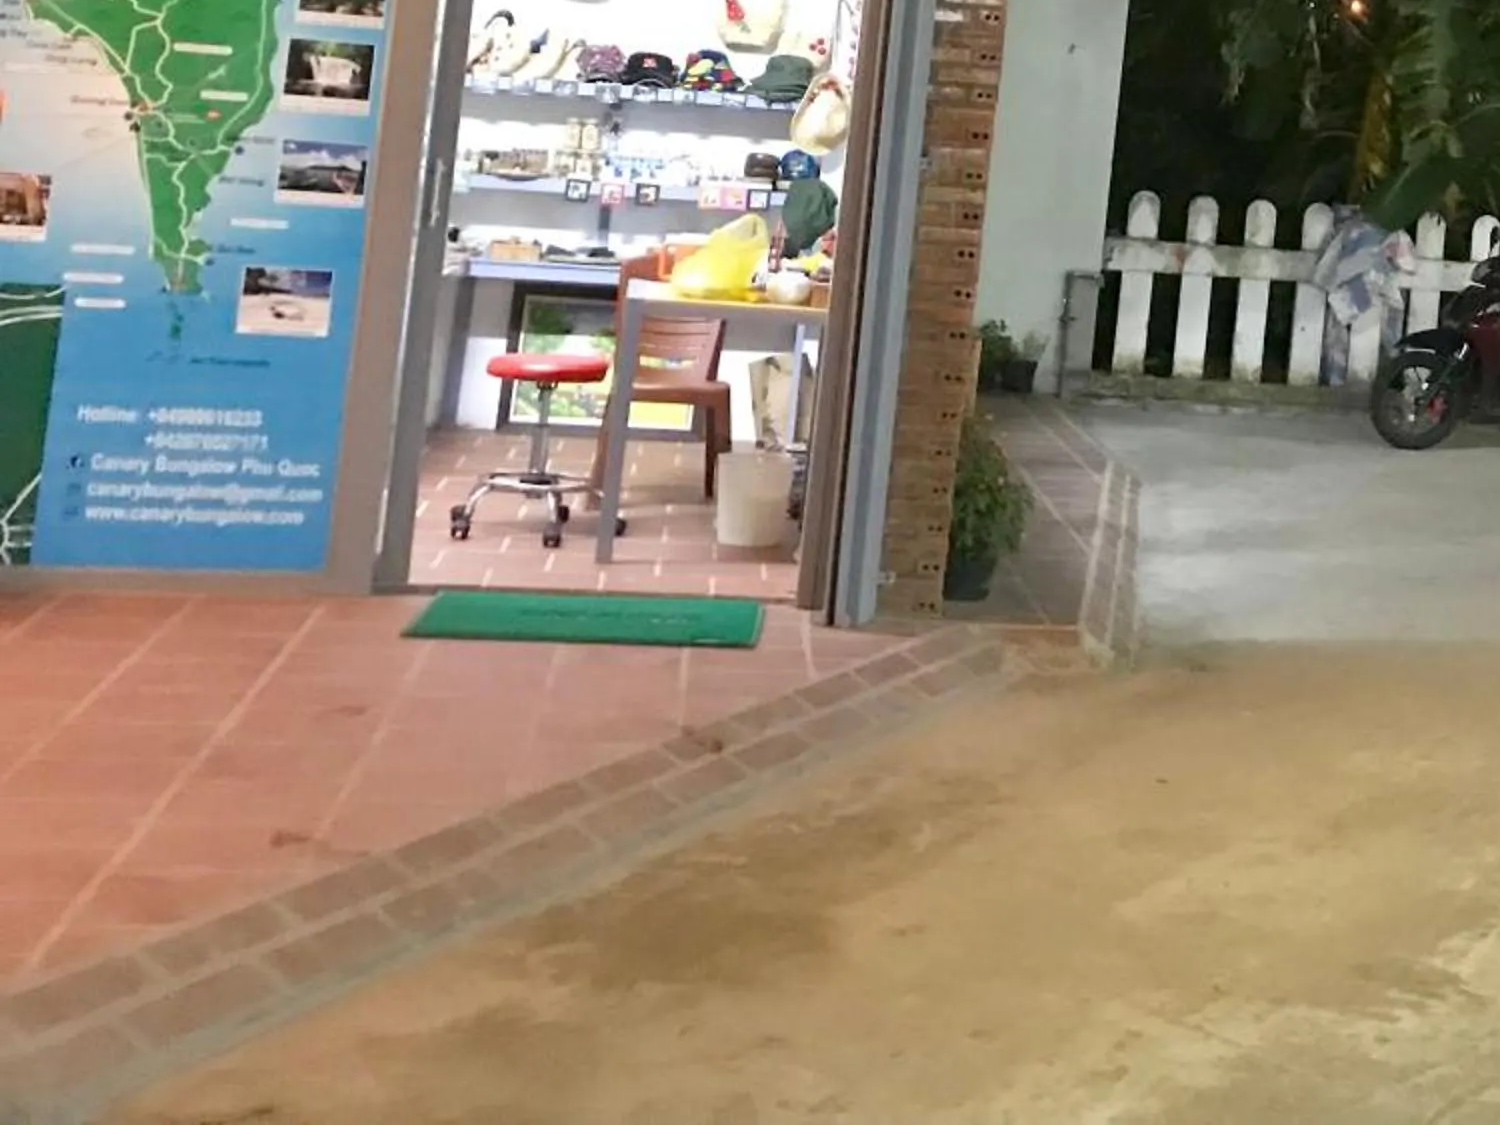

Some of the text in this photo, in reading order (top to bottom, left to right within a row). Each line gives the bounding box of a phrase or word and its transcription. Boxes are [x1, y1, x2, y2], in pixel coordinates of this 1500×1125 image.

[90, 453, 150, 475] Canary
[155, 454, 237, 477] Bungalow
[241, 458, 273, 475] Phu
